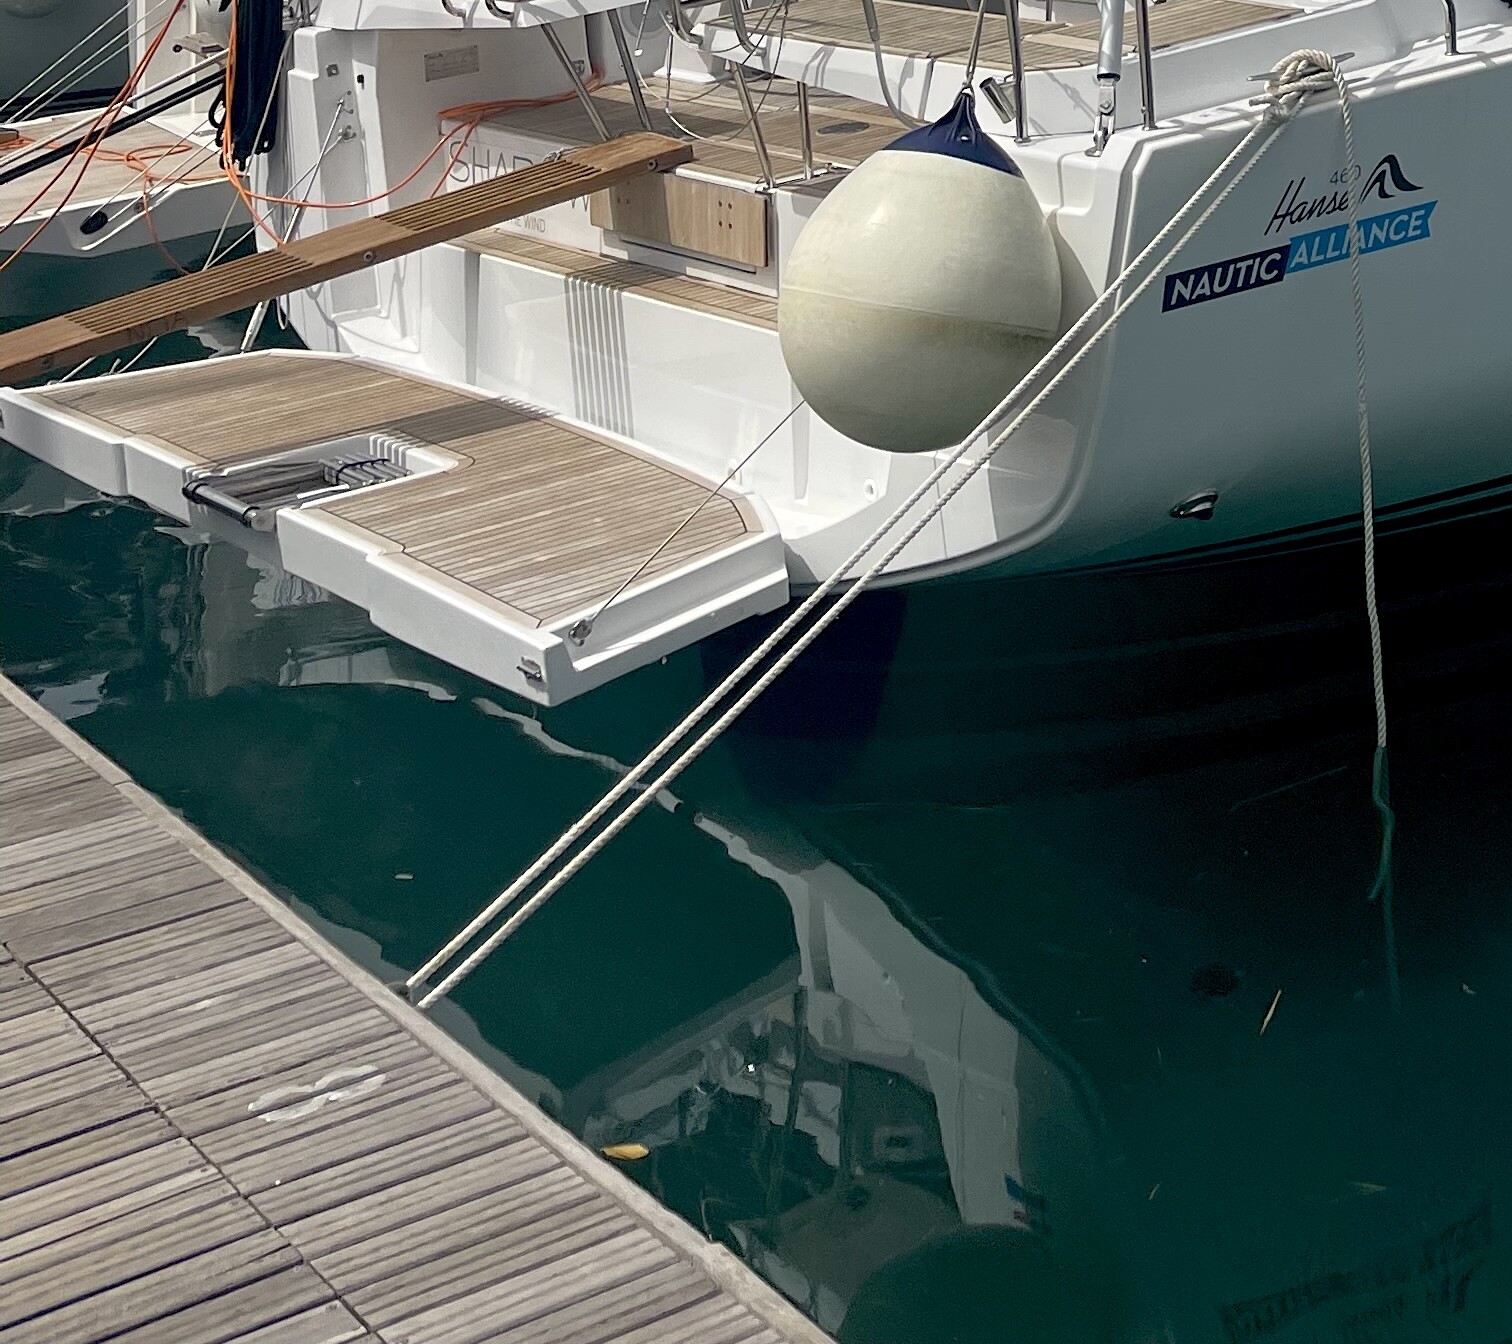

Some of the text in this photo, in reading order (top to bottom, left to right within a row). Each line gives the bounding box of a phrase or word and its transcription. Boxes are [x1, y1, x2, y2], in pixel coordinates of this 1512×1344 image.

[1264, 176, 1350, 236] Hanse
[1170, 209, 1426, 305] NAUTIC ALLIANCE
